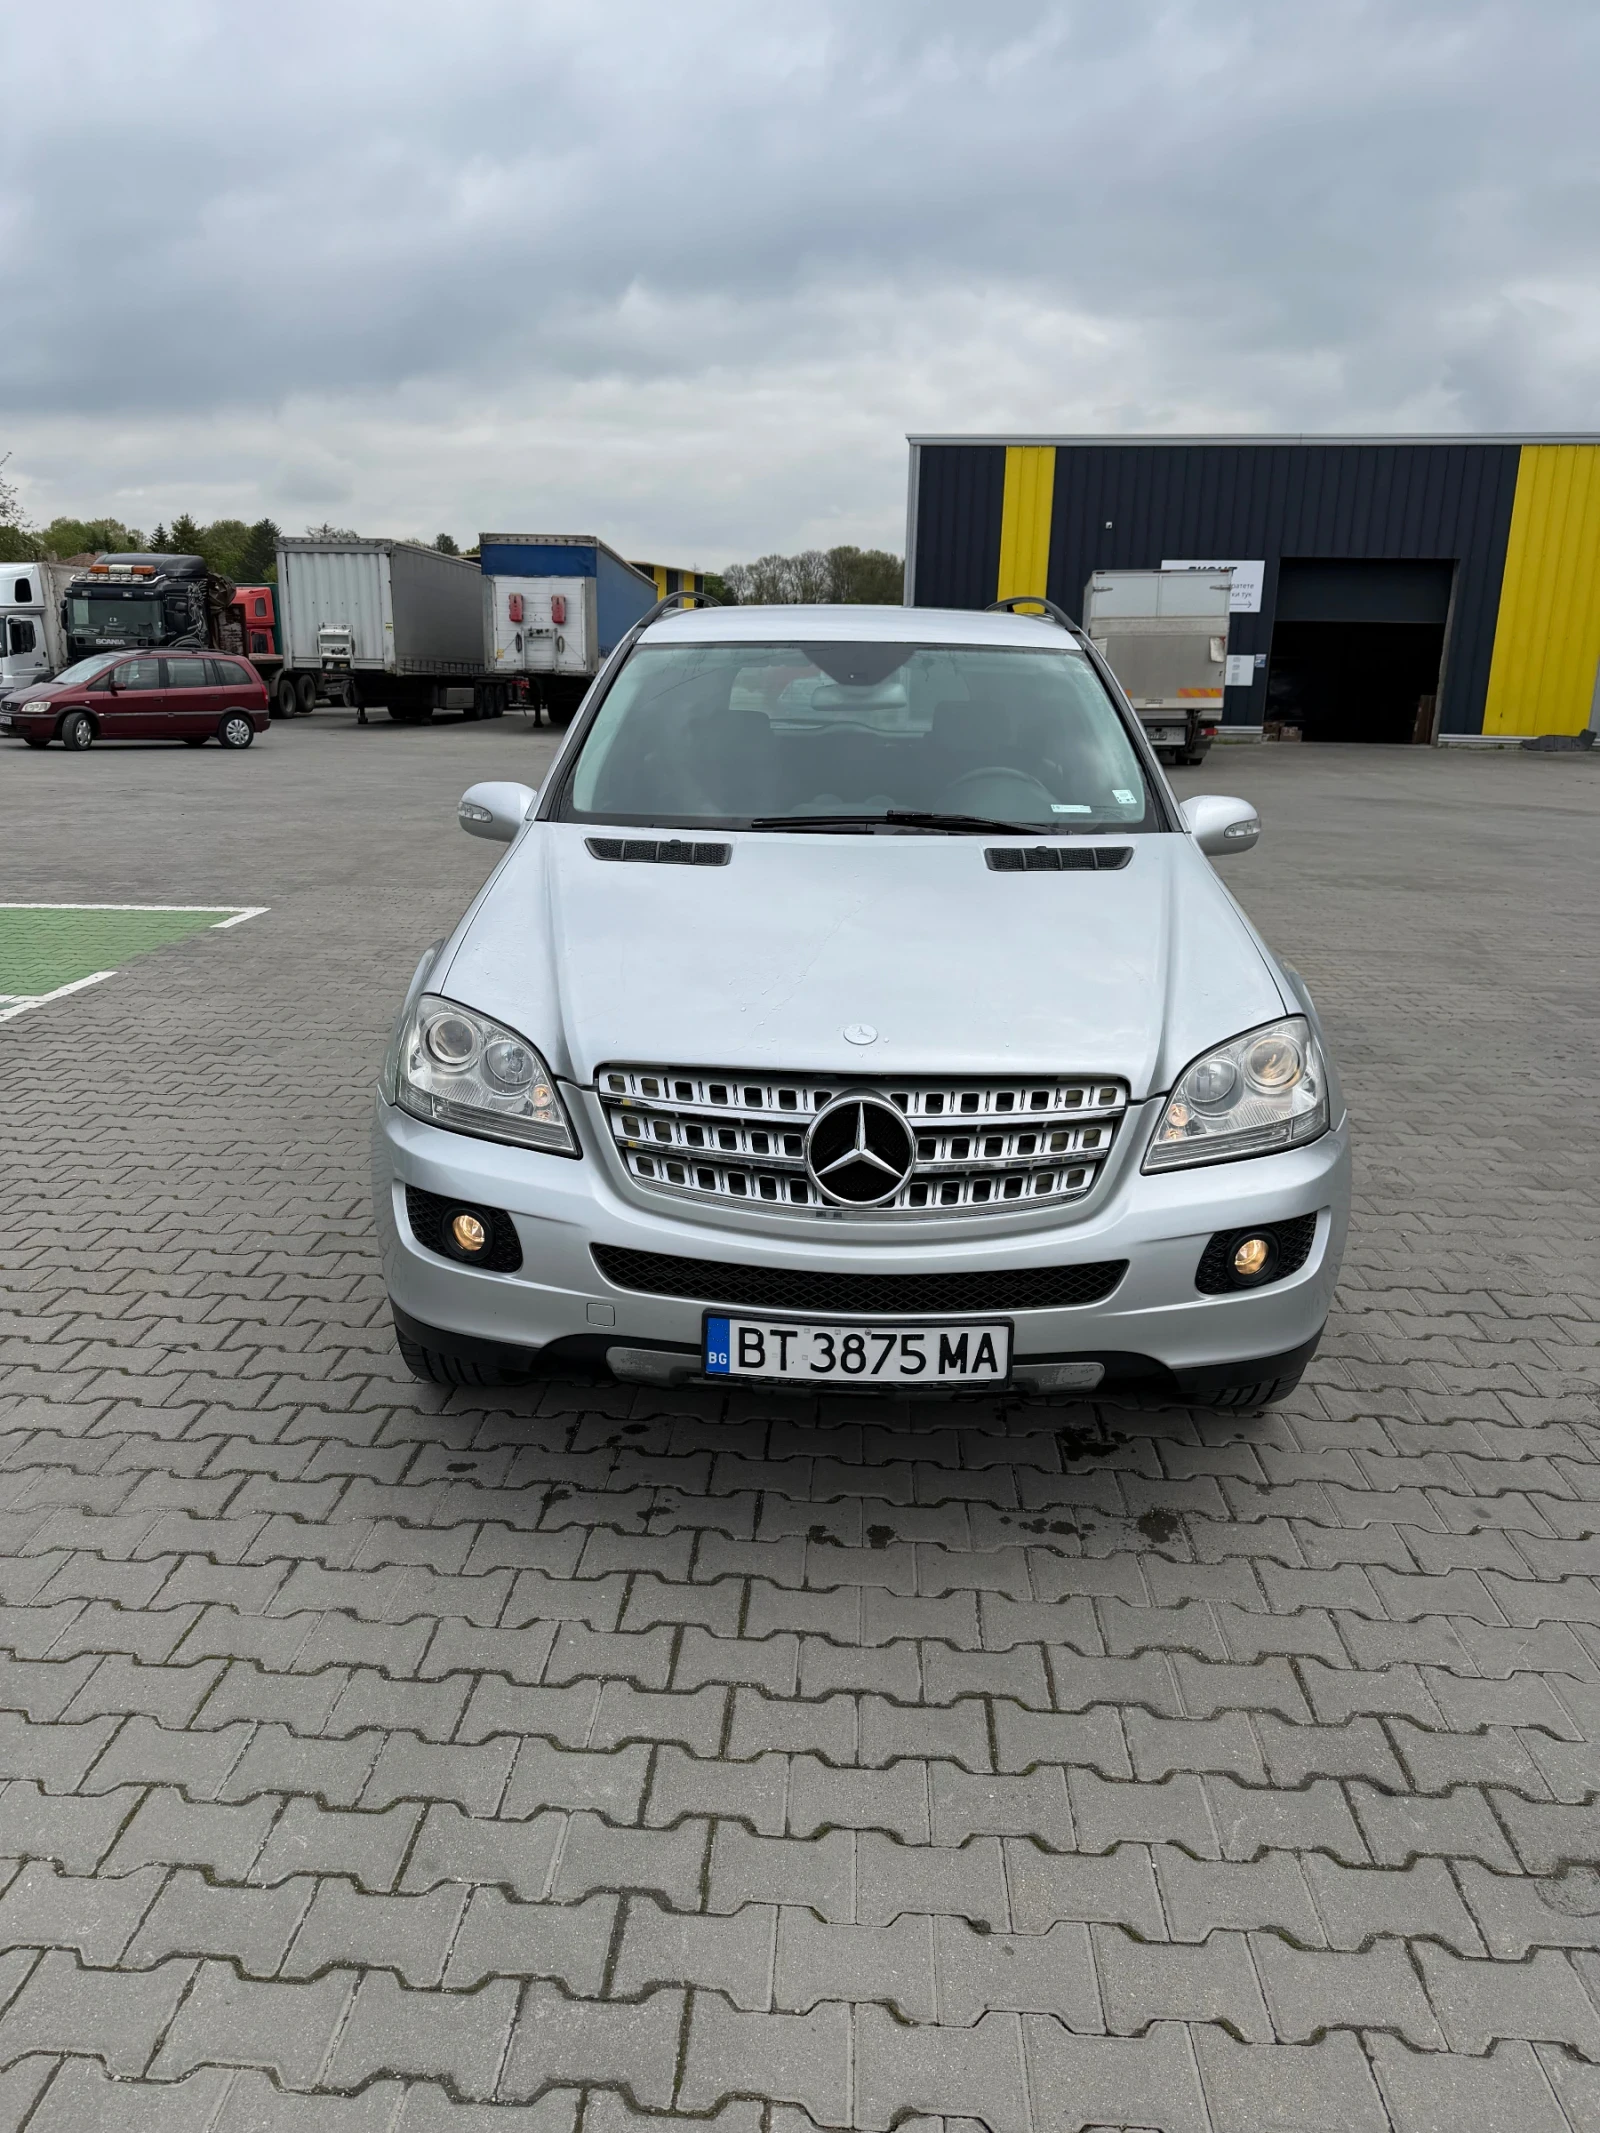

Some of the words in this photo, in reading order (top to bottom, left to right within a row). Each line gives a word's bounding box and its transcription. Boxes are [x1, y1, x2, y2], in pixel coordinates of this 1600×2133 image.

[708, 1351, 728, 1365] BG
[737, 1326, 798, 1371] BT
[809, 1332, 927, 1375] 3875
[937, 1332, 999, 1375] MA
